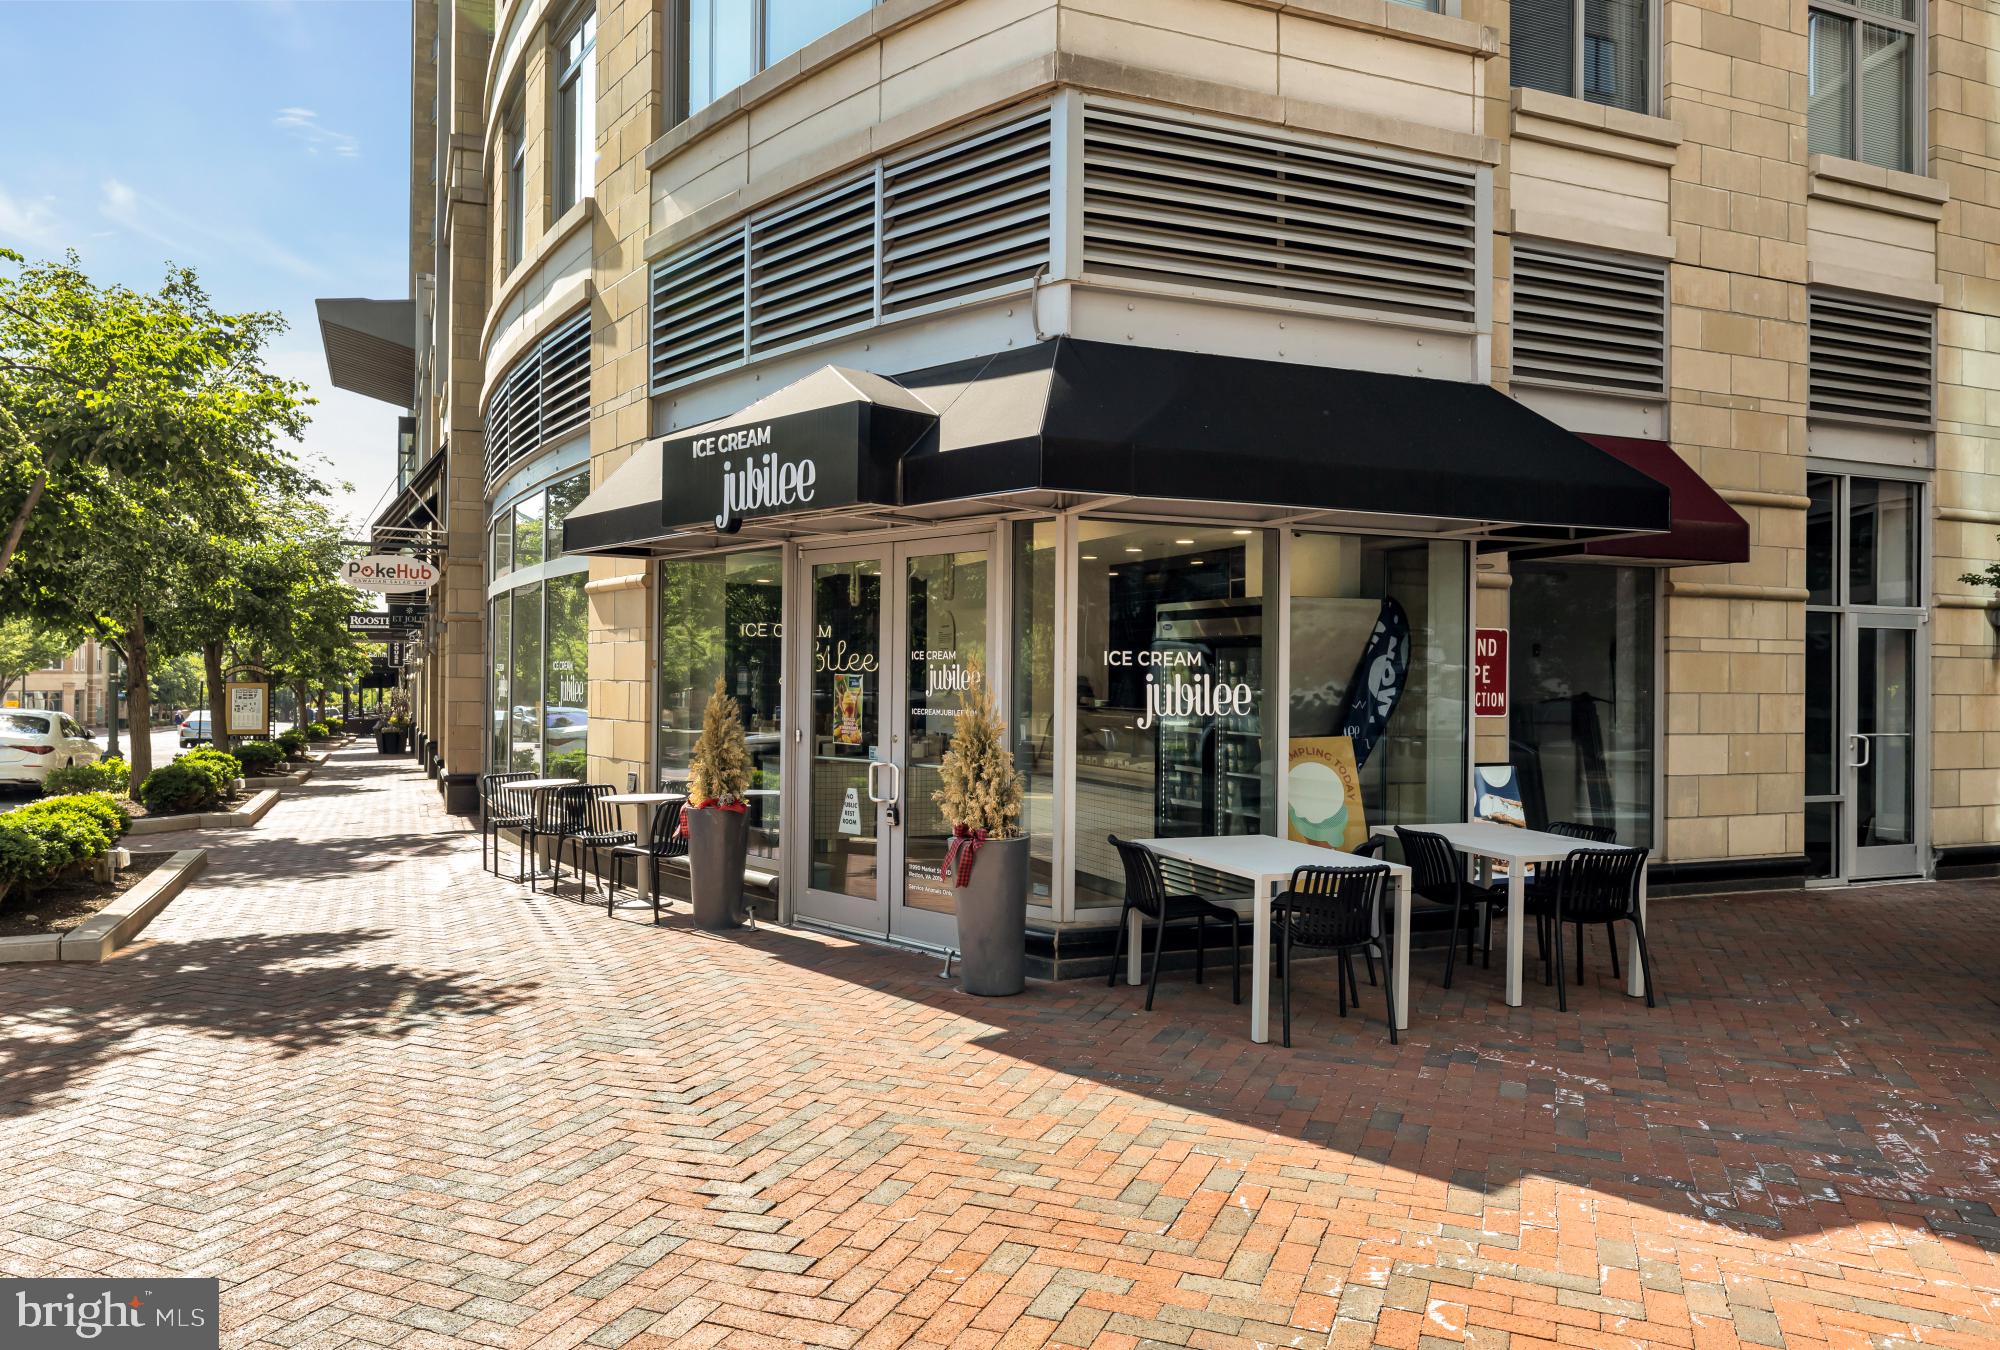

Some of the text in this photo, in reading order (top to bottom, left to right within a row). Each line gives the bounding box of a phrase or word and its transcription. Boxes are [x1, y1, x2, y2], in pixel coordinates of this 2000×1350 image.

[692, 425, 771, 459] ICE CREAM
[715, 452, 816, 529] jubilee
[348, 562, 432, 580] PokeHub
[740, 622, 768, 638] ICE
[815, 640, 879, 672] bilee
[911, 650, 957, 660] ICE CREAM
[1476, 638, 1497, 657] ND
[1103, 650, 1202, 667] ICE CREAM
[925, 664, 981, 697] jubilee
[1136, 673, 1252, 730] jubilee
[1475, 692, 1505, 708] CTION
[1289, 745, 1333, 762] MPLING
